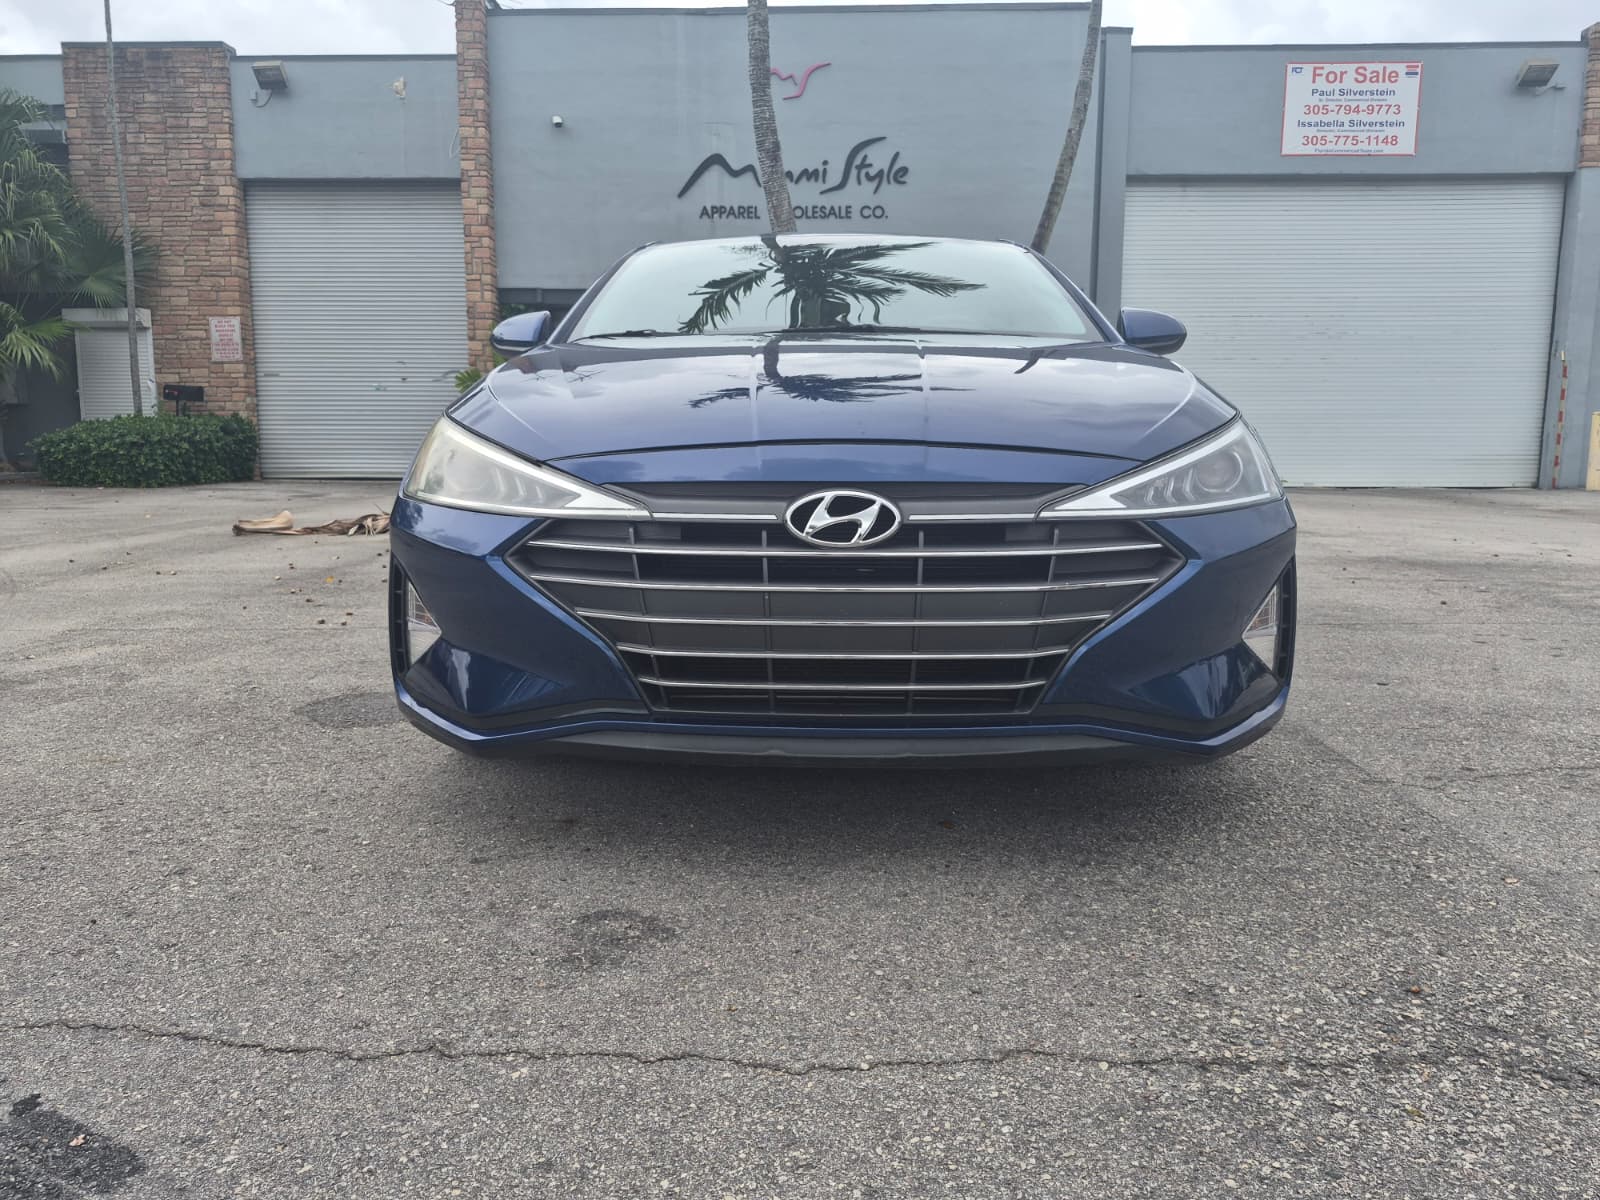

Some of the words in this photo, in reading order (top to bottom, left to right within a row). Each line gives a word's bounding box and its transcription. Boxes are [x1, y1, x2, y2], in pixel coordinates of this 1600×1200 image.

[1312, 66, 1348, 84] For
[1354, 65, 1399, 84] Sale
[1311, 88, 1335, 96] Paul
[1338, 88, 1396, 96] Silverstein
[1303, 104, 1401, 115] 305-794-9773
[1297, 119, 1345, 128] Issabella
[1348, 119, 1405, 128] Silverstein
[1302, 135, 1399, 146] 305-775-1148
[677, 153, 829, 199] Mmi
[819, 136, 909, 195] Style
[699, 205, 760, 219] APPAREL
[791, 205, 852, 219] OLESALE
[860, 205, 888, 219] CO.
